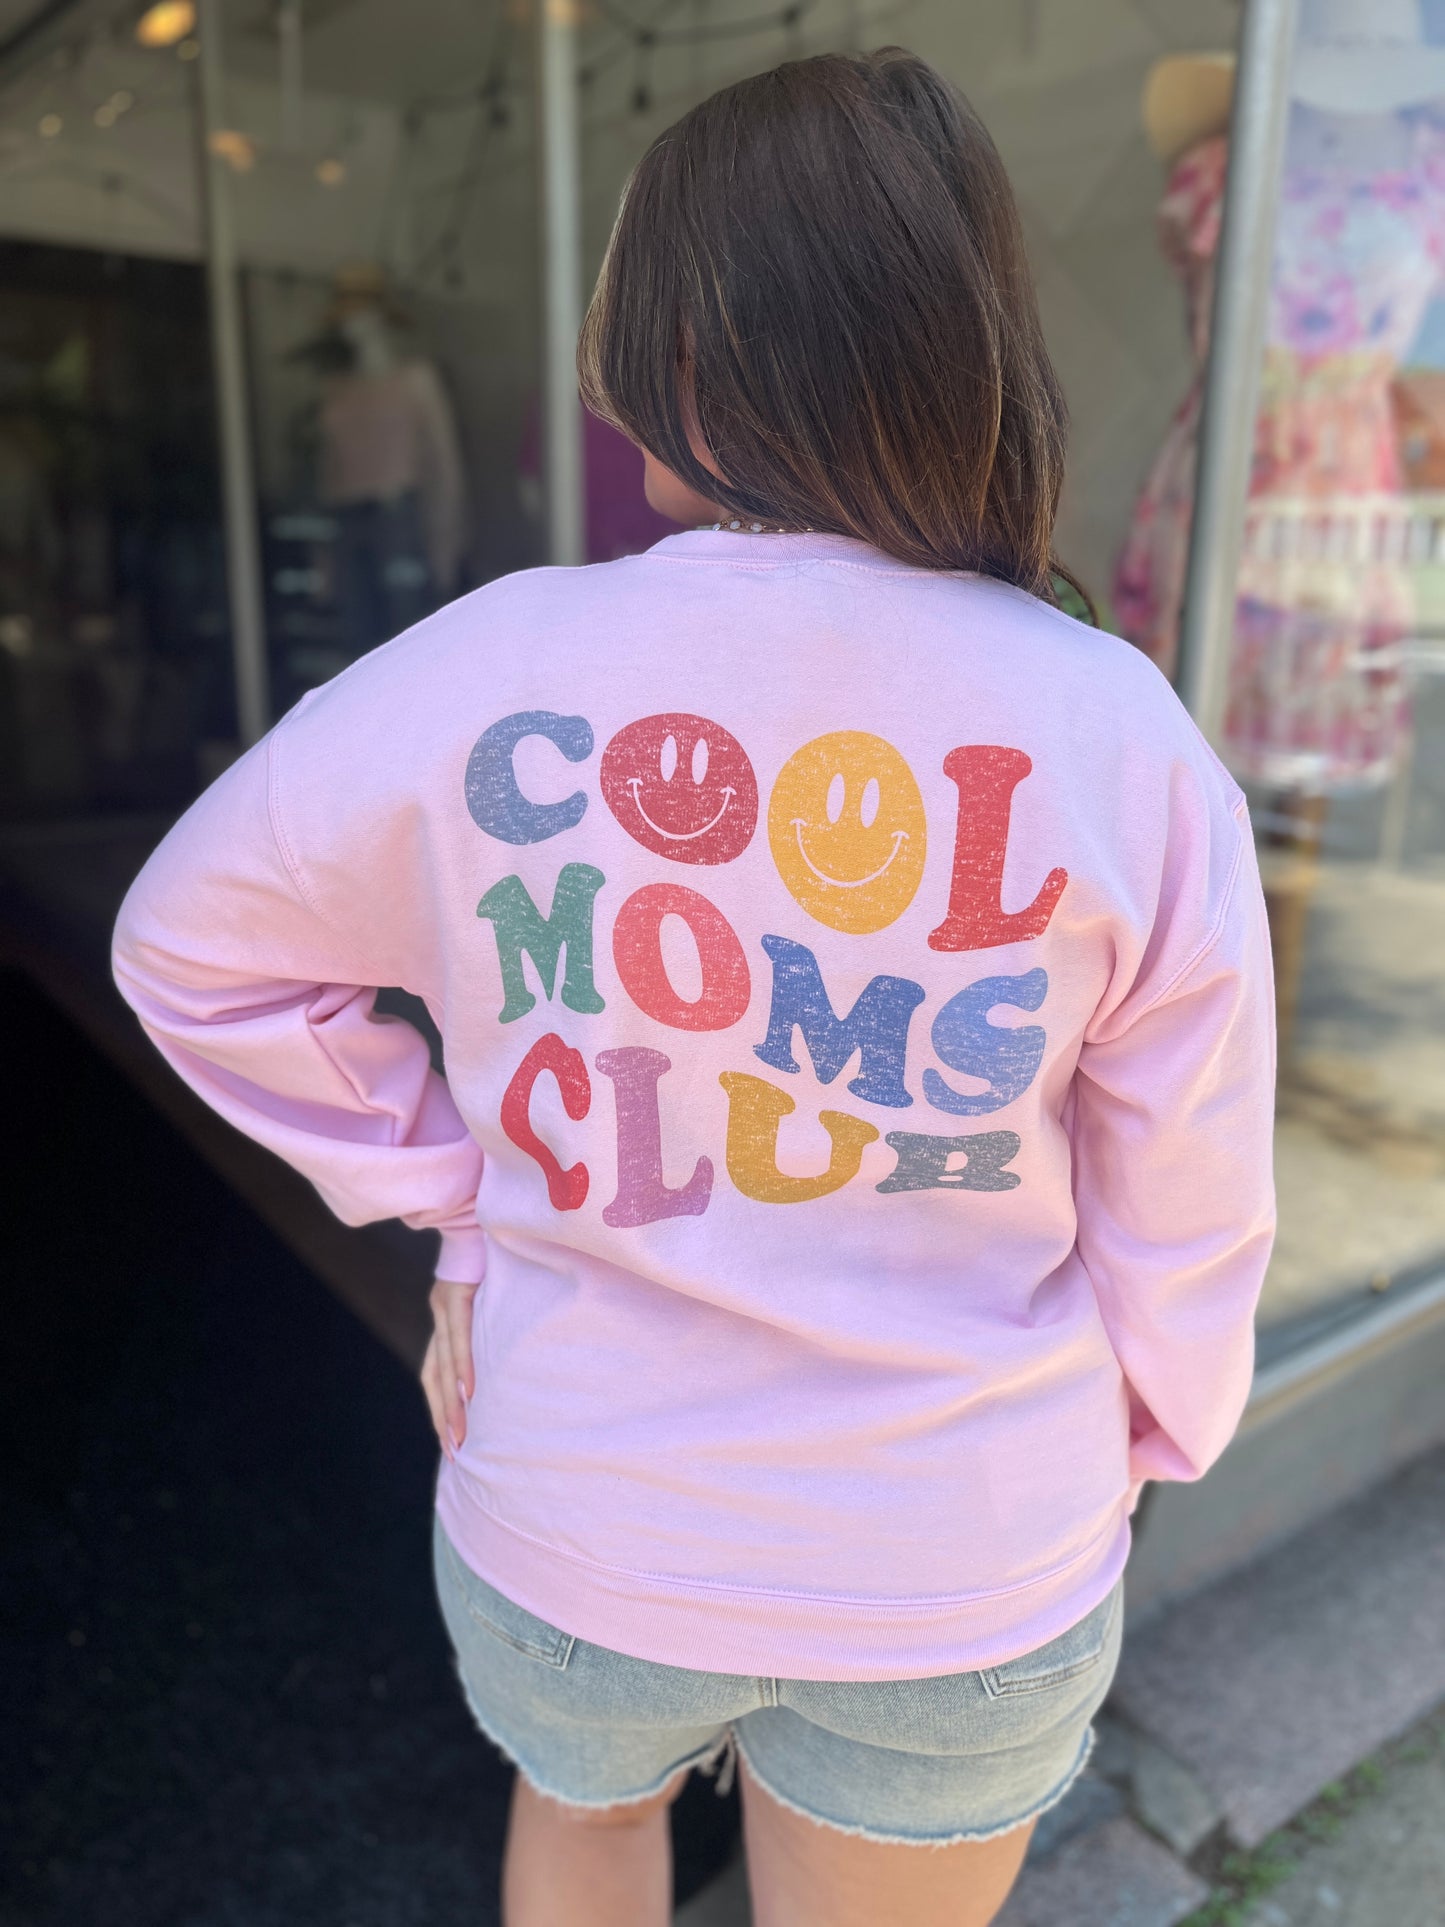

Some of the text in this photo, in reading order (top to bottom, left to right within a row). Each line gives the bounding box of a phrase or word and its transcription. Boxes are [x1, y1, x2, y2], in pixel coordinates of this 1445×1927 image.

[464, 709, 1069, 952] COOL
[476, 861, 1049, 1117] MOMS
[500, 1032, 1022, 1229] CLUB
